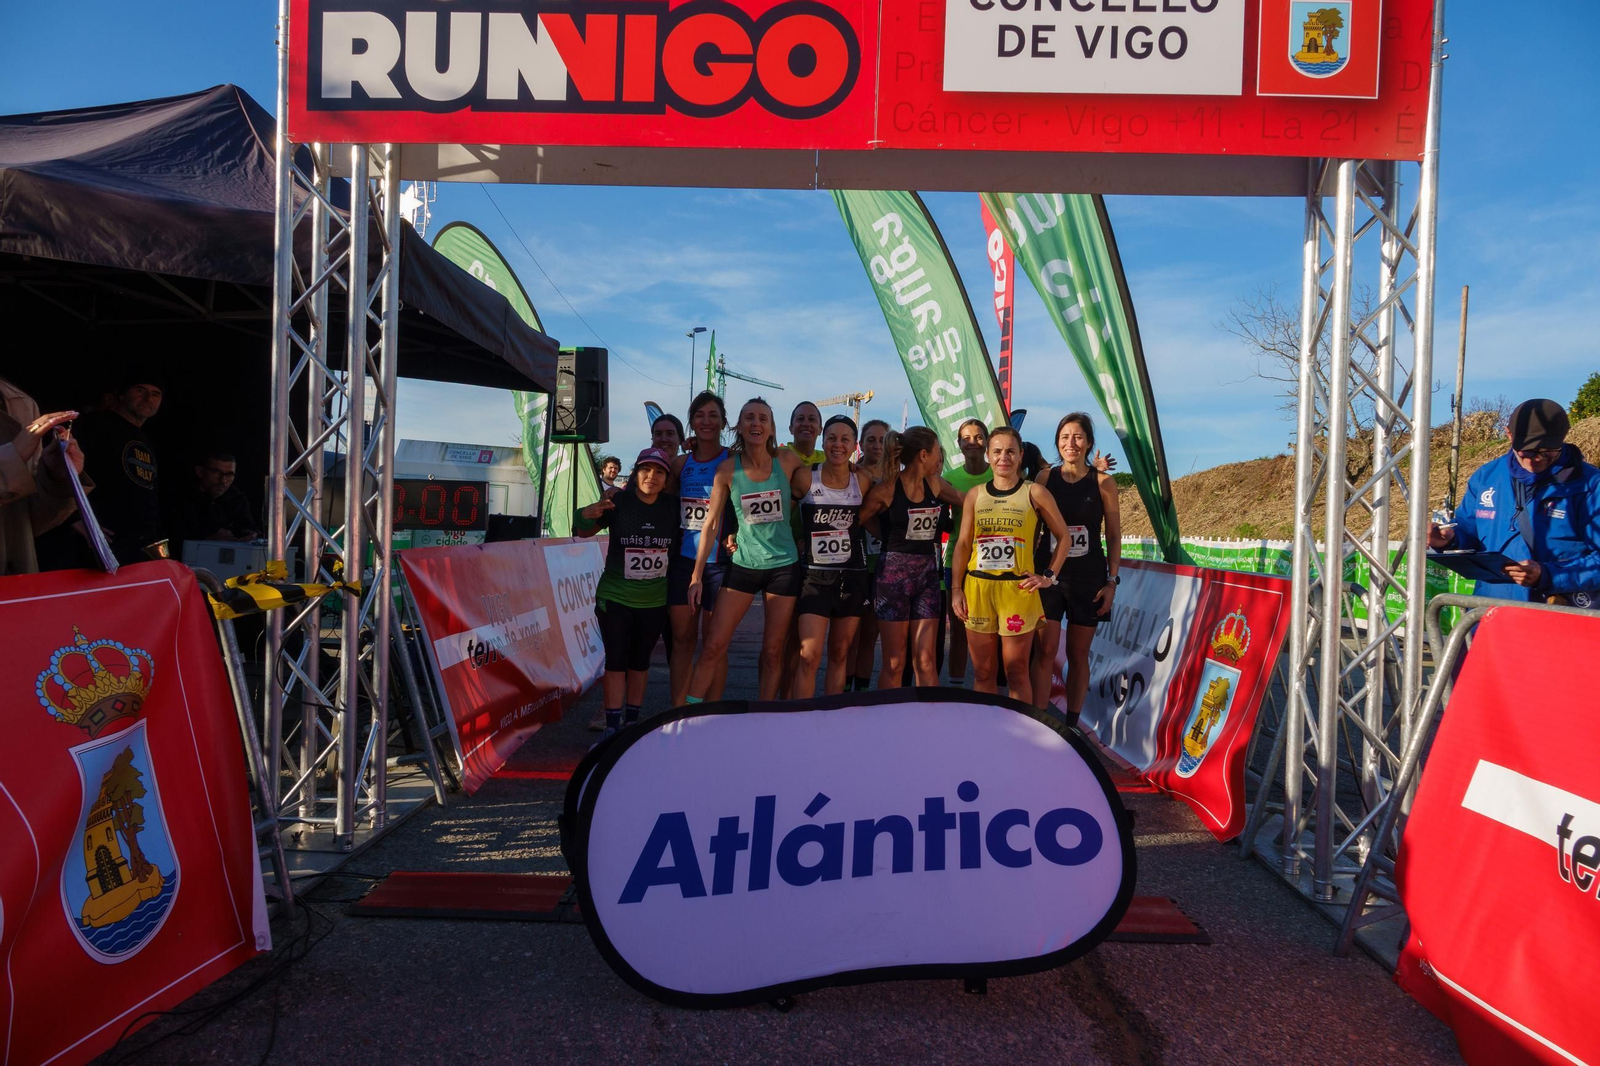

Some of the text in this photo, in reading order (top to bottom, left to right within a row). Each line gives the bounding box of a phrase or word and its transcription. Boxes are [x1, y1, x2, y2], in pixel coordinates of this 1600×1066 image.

[997, 24, 1189, 60] DE VIGO
[892, 103, 1028, 136] Cáncer
[1065, 105, 1149, 144] Vigo
[1168, 107, 1223, 139] +11
[1262, 109, 1302, 140] La
[1319, 110, 1359, 142] 21
[685, 506, 709, 520] 20
[749, 499, 781, 515] 201
[912, 517, 938, 531] 203
[976, 517, 1023, 528] ATHLETICS
[981, 525, 1014, 533] San Lázaro
[436, 535, 468, 546] cidade
[619, 534, 644, 545] máis
[652, 537, 673, 547] auga
[818, 539, 851, 554] 205
[1070, 534, 1087, 548] 14
[981, 545, 1015, 560] 209
[630, 556, 663, 571] 206
[557, 568, 603, 614] CONCEL
[573, 620, 598, 659] DE
[513, 708, 519, 721] A
[617, 780, 1104, 905] Atlántico
